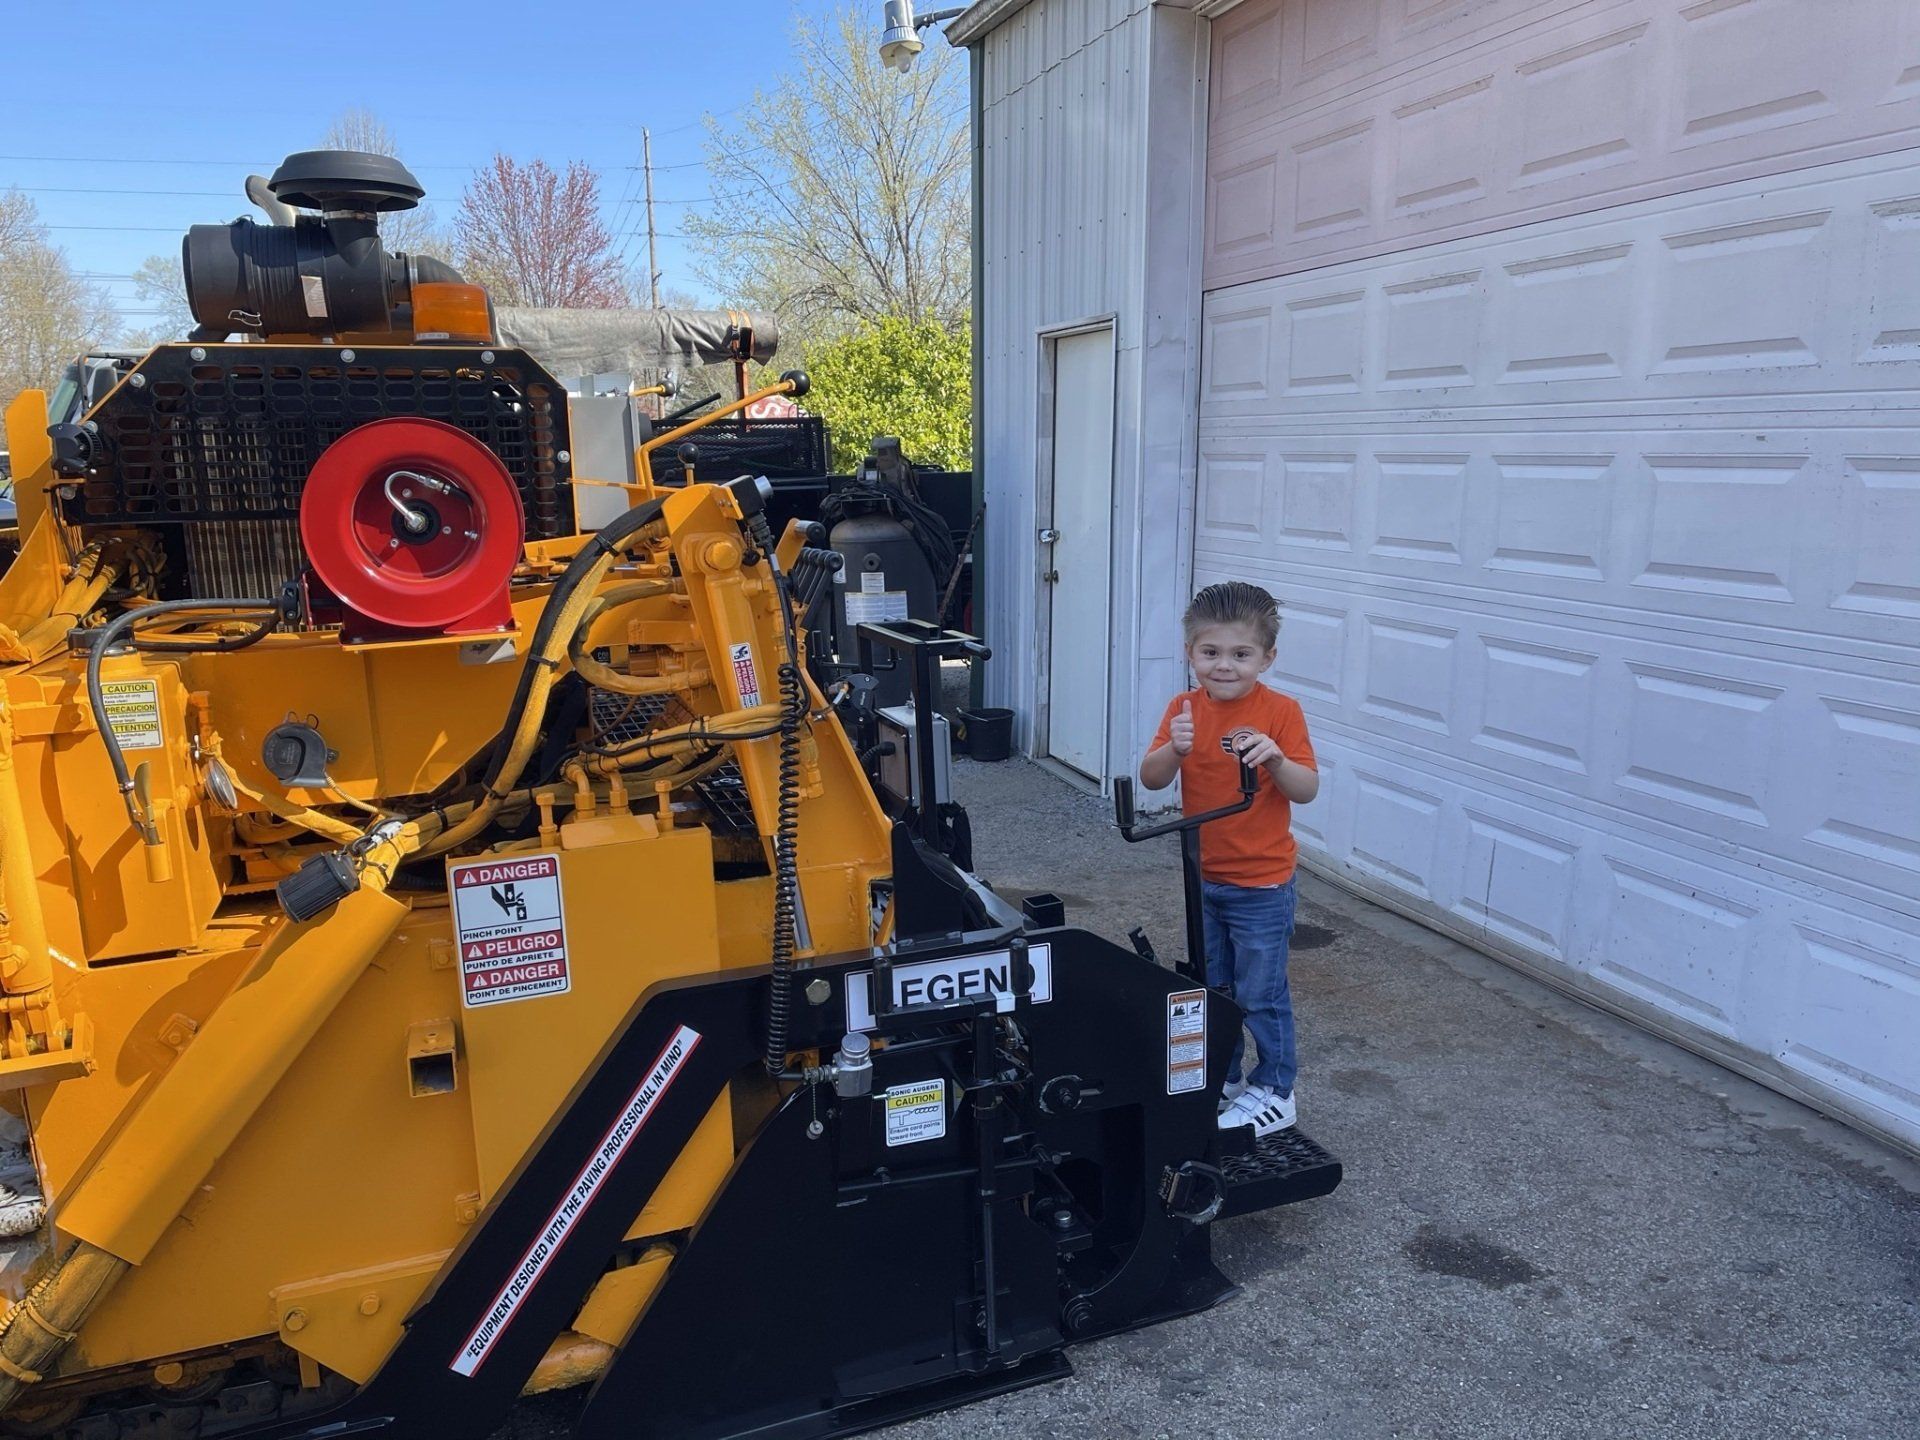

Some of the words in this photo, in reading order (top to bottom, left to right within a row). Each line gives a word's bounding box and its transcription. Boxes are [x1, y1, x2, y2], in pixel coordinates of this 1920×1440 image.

[107, 684, 148, 693] CAUTION
[105, 704, 155, 713] PRECAUCION
[112, 723, 157, 732] TTENTION
[479, 861, 550, 882] DANGER
[463, 930, 492, 941] PINCH
[495, 925, 523, 936] POINT
[485, 934, 558, 956] PELIGRO
[466, 959, 499, 971] PUNTO
[501, 956, 513, 965] DE
[515, 951, 555, 964] APRIETE
[490, 963, 559, 985] DANGER
[469, 989, 496, 1000] POINT
[499, 986, 511, 995] DE
[513, 979, 563, 993] PINCEMENT
[891, 1088, 911, 1097] SONIC
[912, 1084, 939, 1093] AUGERS
[895, 1093, 936, 1107] CAUTION
[510, 1243, 549, 1297] DESIGNED
[544, 1215, 568, 1246] WITH
[562, 1193, 582, 1219] THE
[577, 1157, 607, 1199] PAVING
[603, 1085, 657, 1161] PROFESSIONAL
[651, 1070, 665, 1088] IN
